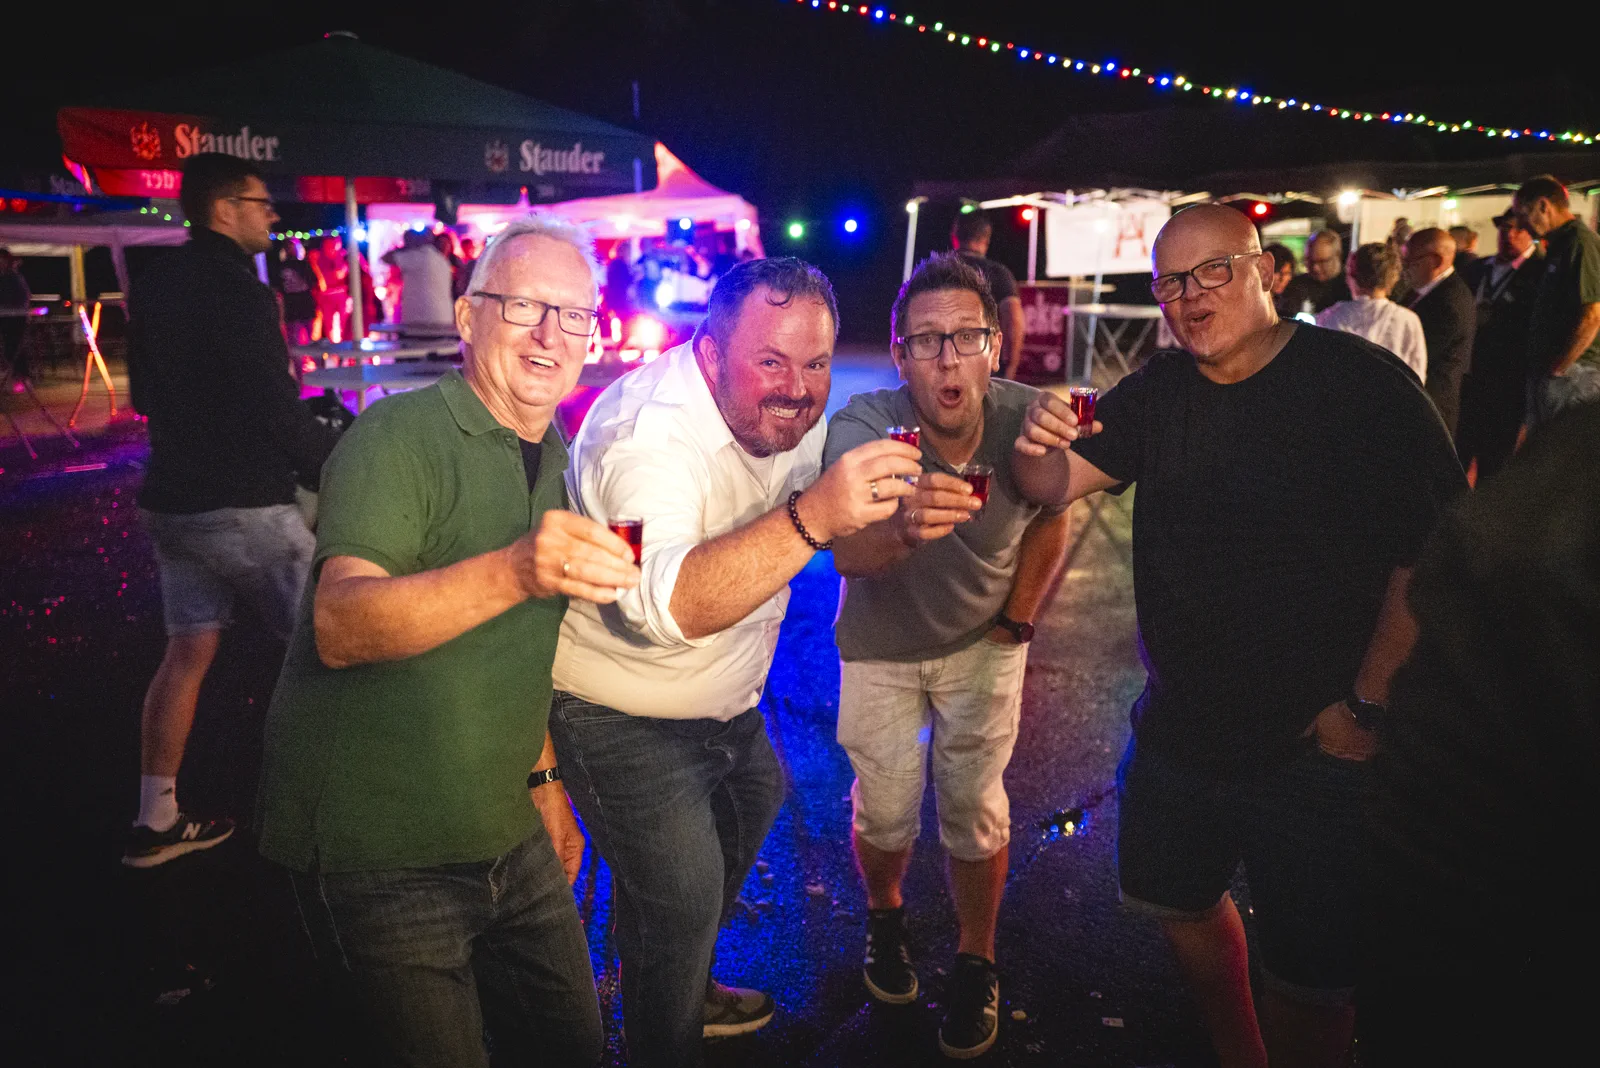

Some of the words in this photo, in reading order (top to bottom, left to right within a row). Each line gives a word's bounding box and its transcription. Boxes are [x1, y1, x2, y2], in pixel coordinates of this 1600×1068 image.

[174, 122, 280, 161] Stauder
[519, 139, 606, 175] Stauder
[181, 822, 202, 840] N
